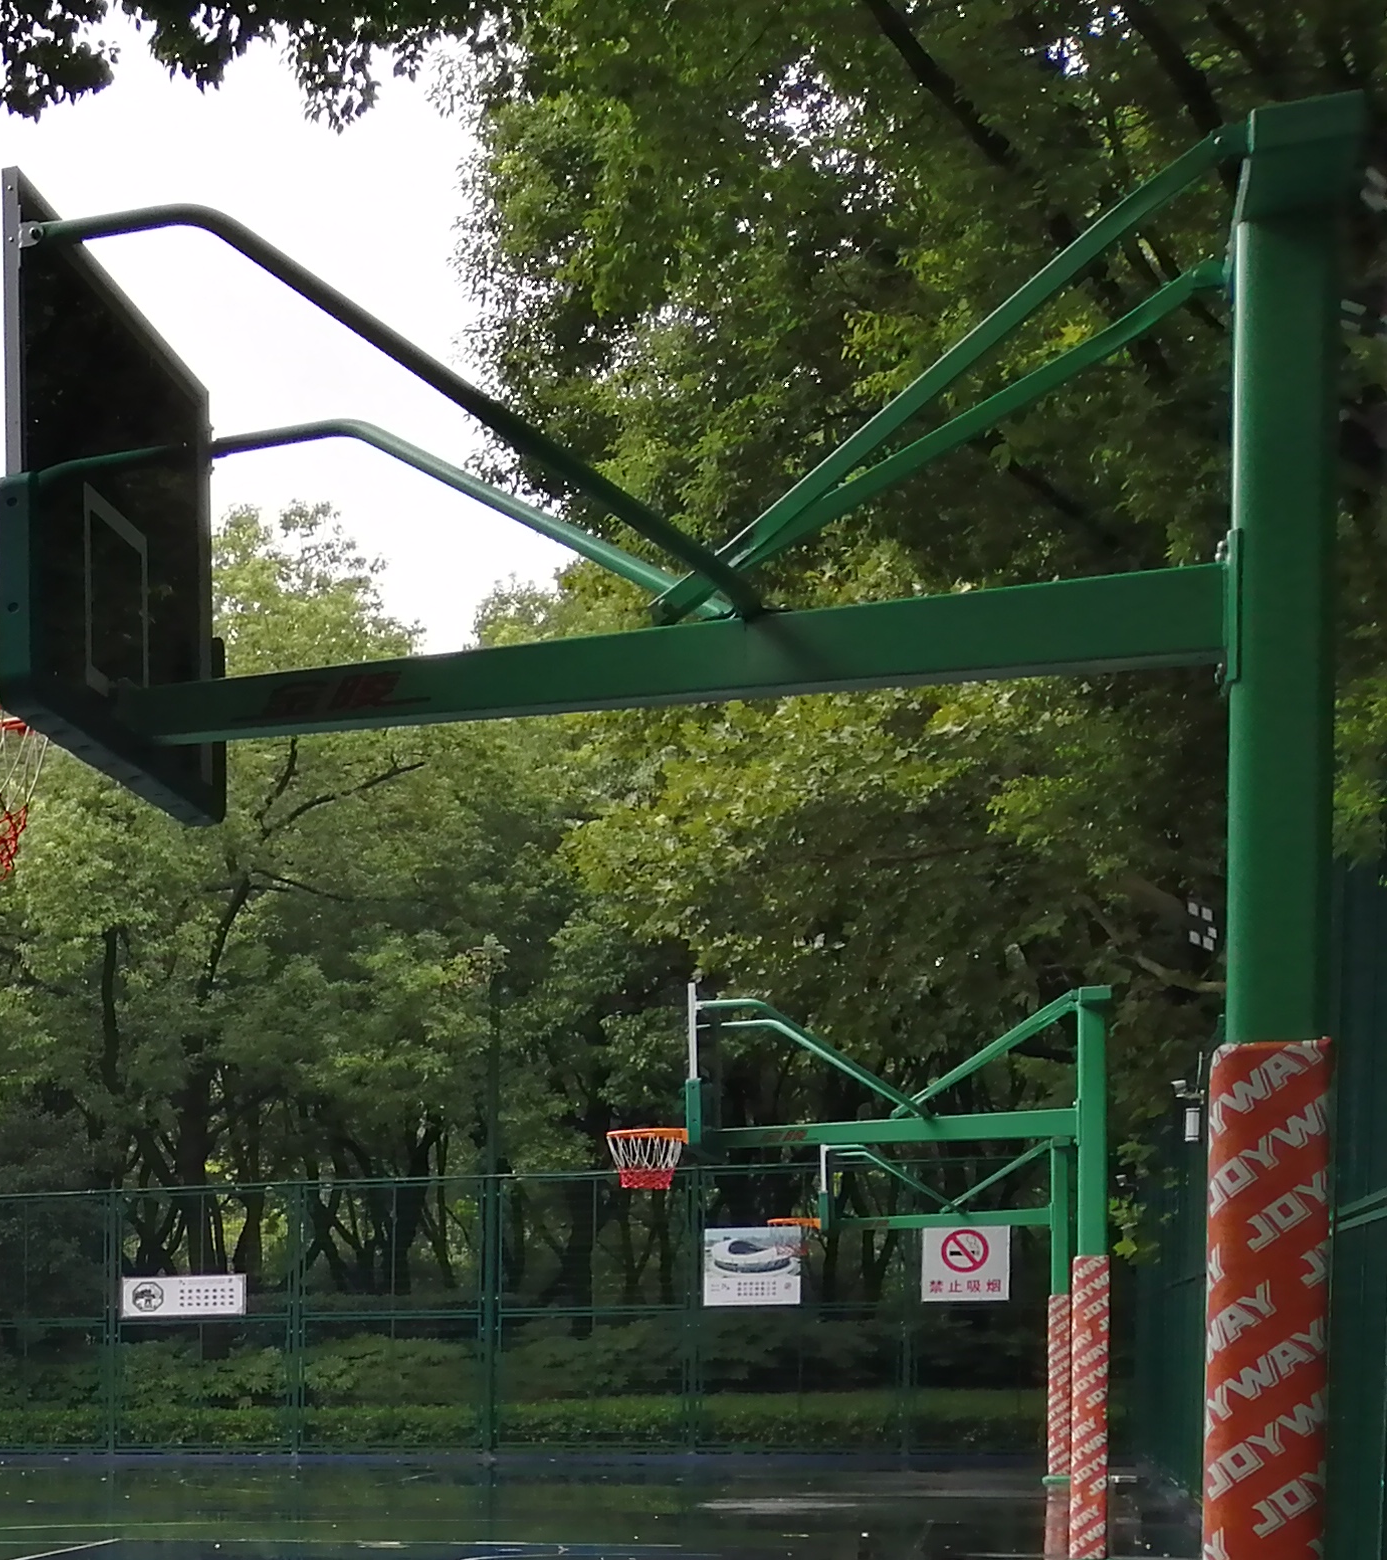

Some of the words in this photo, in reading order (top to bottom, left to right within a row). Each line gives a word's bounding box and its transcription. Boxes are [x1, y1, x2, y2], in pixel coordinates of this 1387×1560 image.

[1209, 1095, 1328, 1217] JOYW
[930, 1279, 1001, 1294] 禁止吸烟
